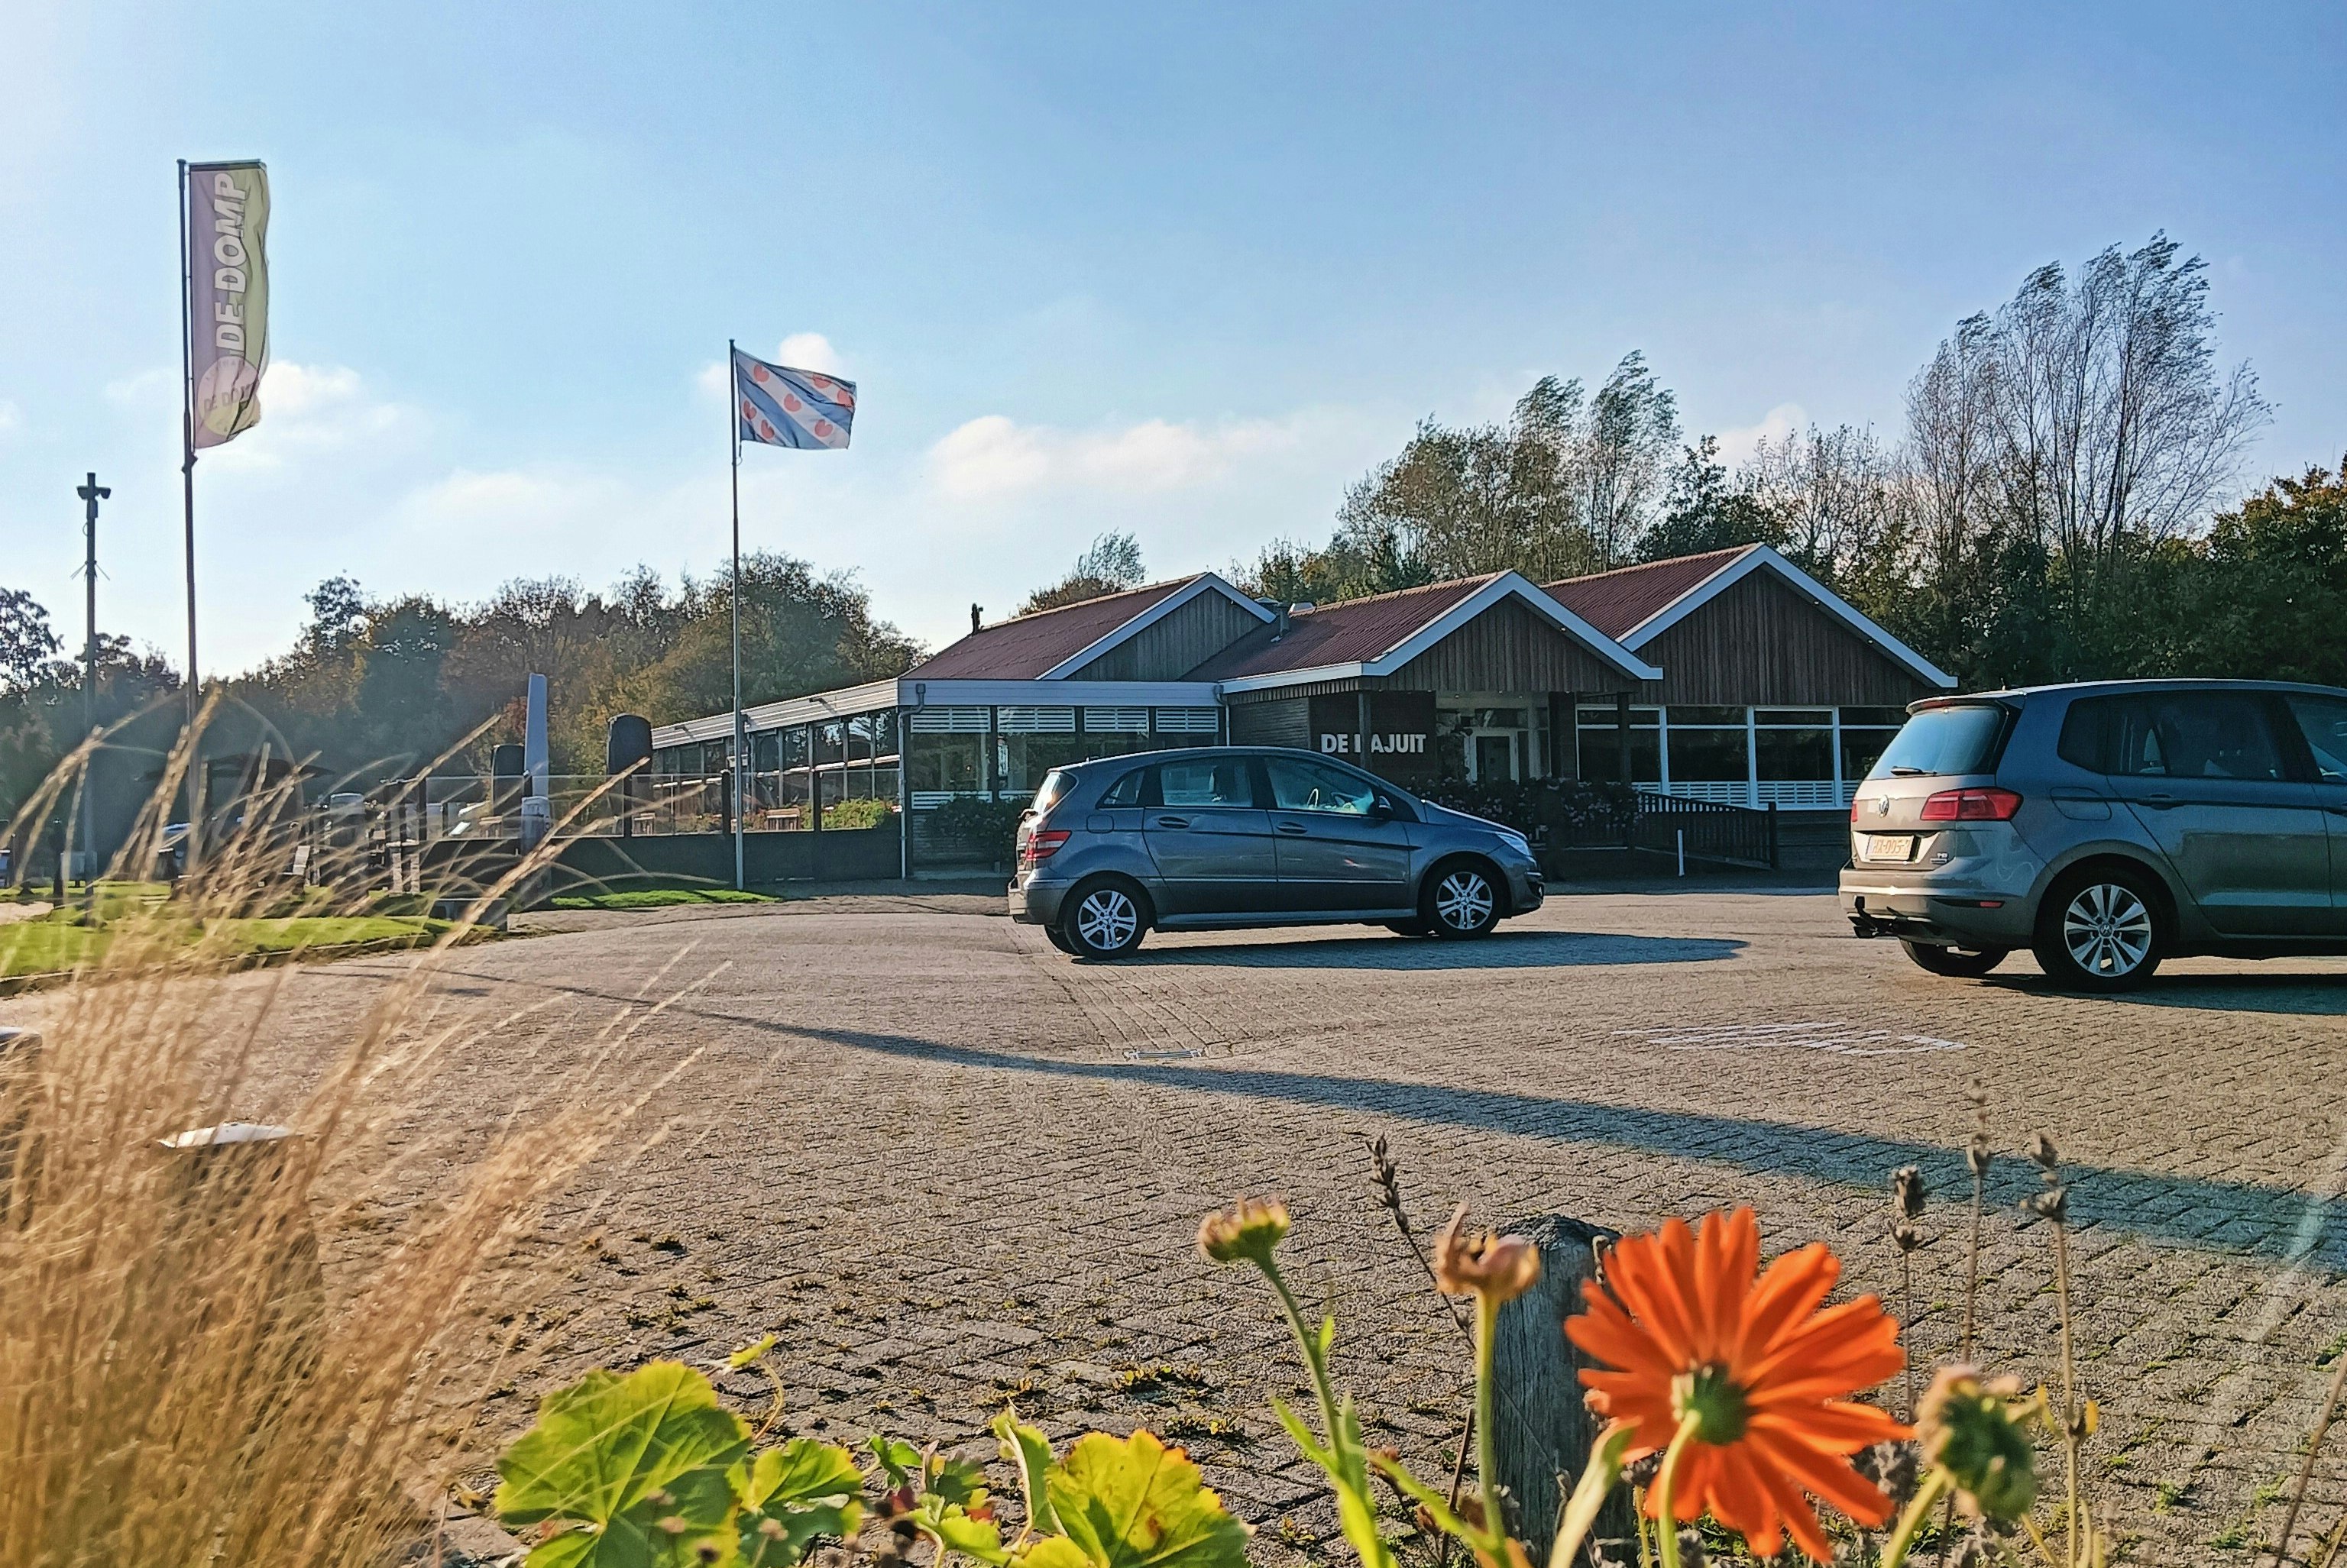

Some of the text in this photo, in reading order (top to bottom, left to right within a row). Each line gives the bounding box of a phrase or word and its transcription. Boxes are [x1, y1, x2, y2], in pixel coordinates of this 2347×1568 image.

[215, 173, 247, 293] DOMP
[215, 302, 245, 351] DE
[1321, 734, 1348, 753] DE
